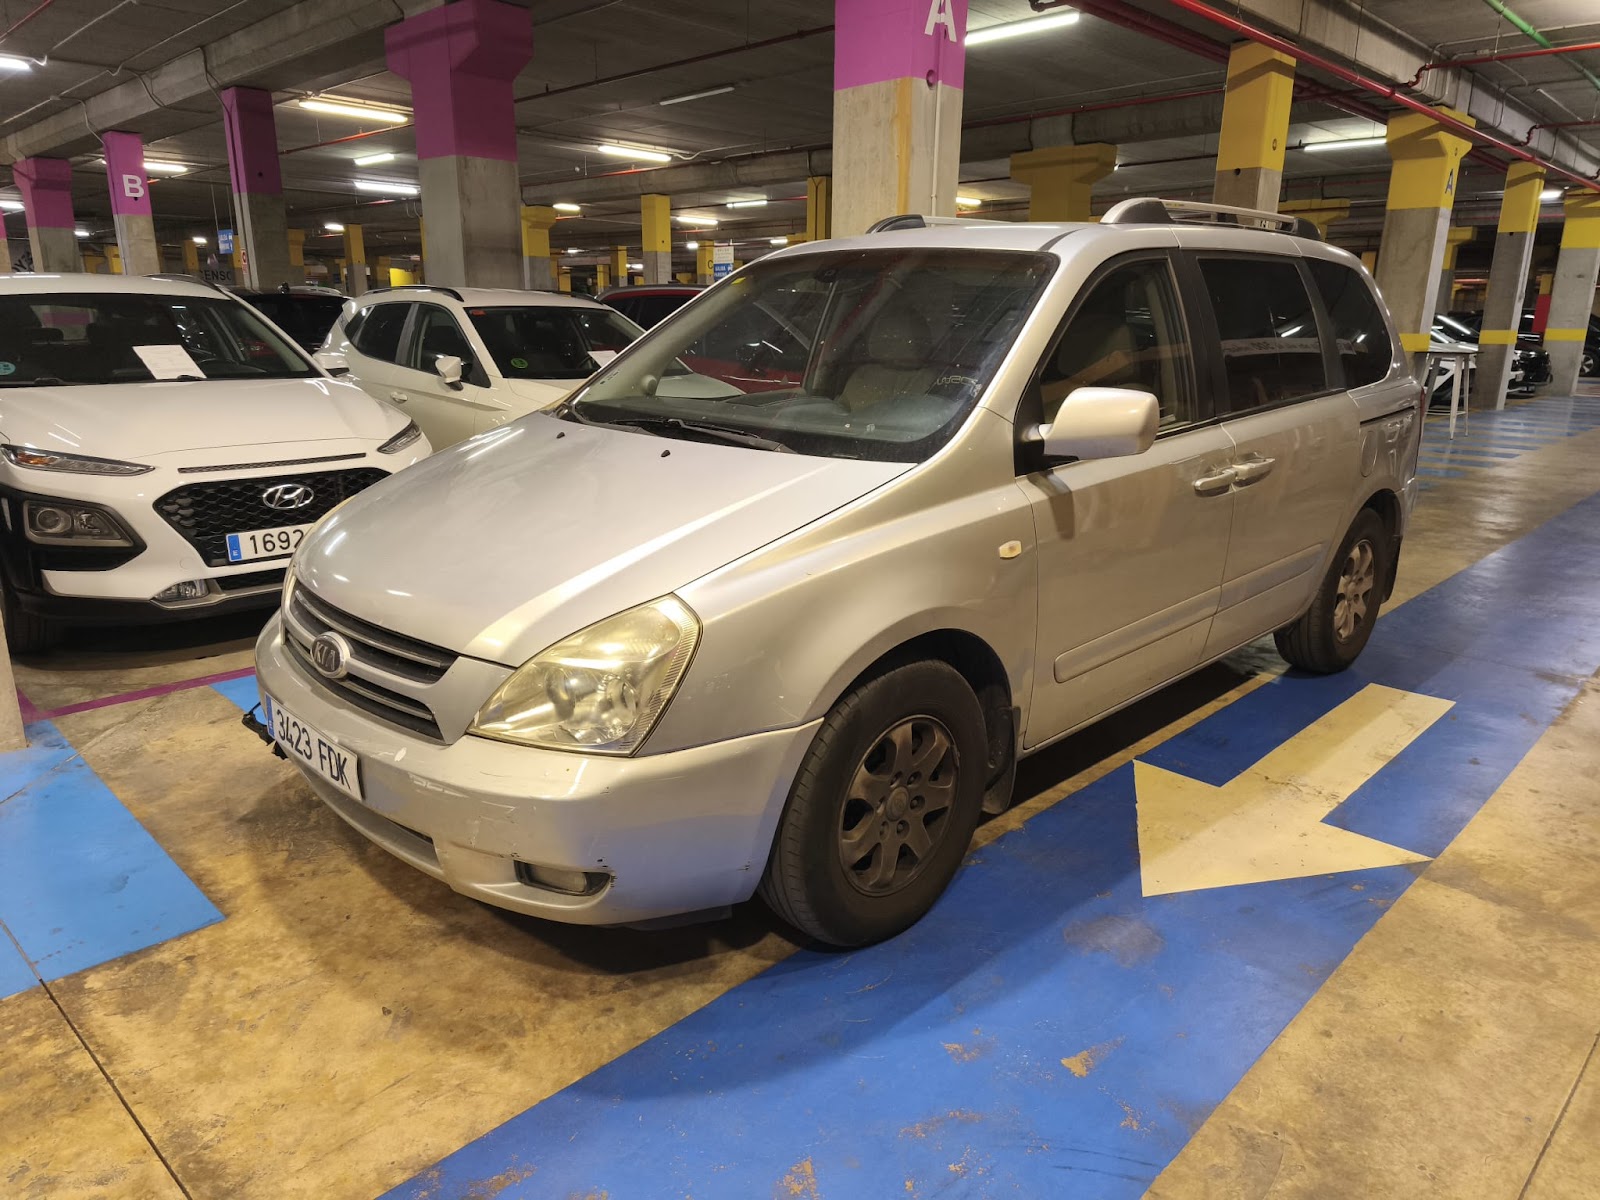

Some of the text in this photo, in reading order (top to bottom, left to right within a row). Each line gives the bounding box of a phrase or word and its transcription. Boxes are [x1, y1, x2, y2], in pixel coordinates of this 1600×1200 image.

[924, 0, 957, 43] A
[122, 174, 145, 198] B
[1444, 168, 1454, 196] A
[249, 529, 304, 555] 1692
[314, 641, 336, 671] KIA
[276, 709, 313, 760] 3423
[317, 738, 351, 789] FDK
